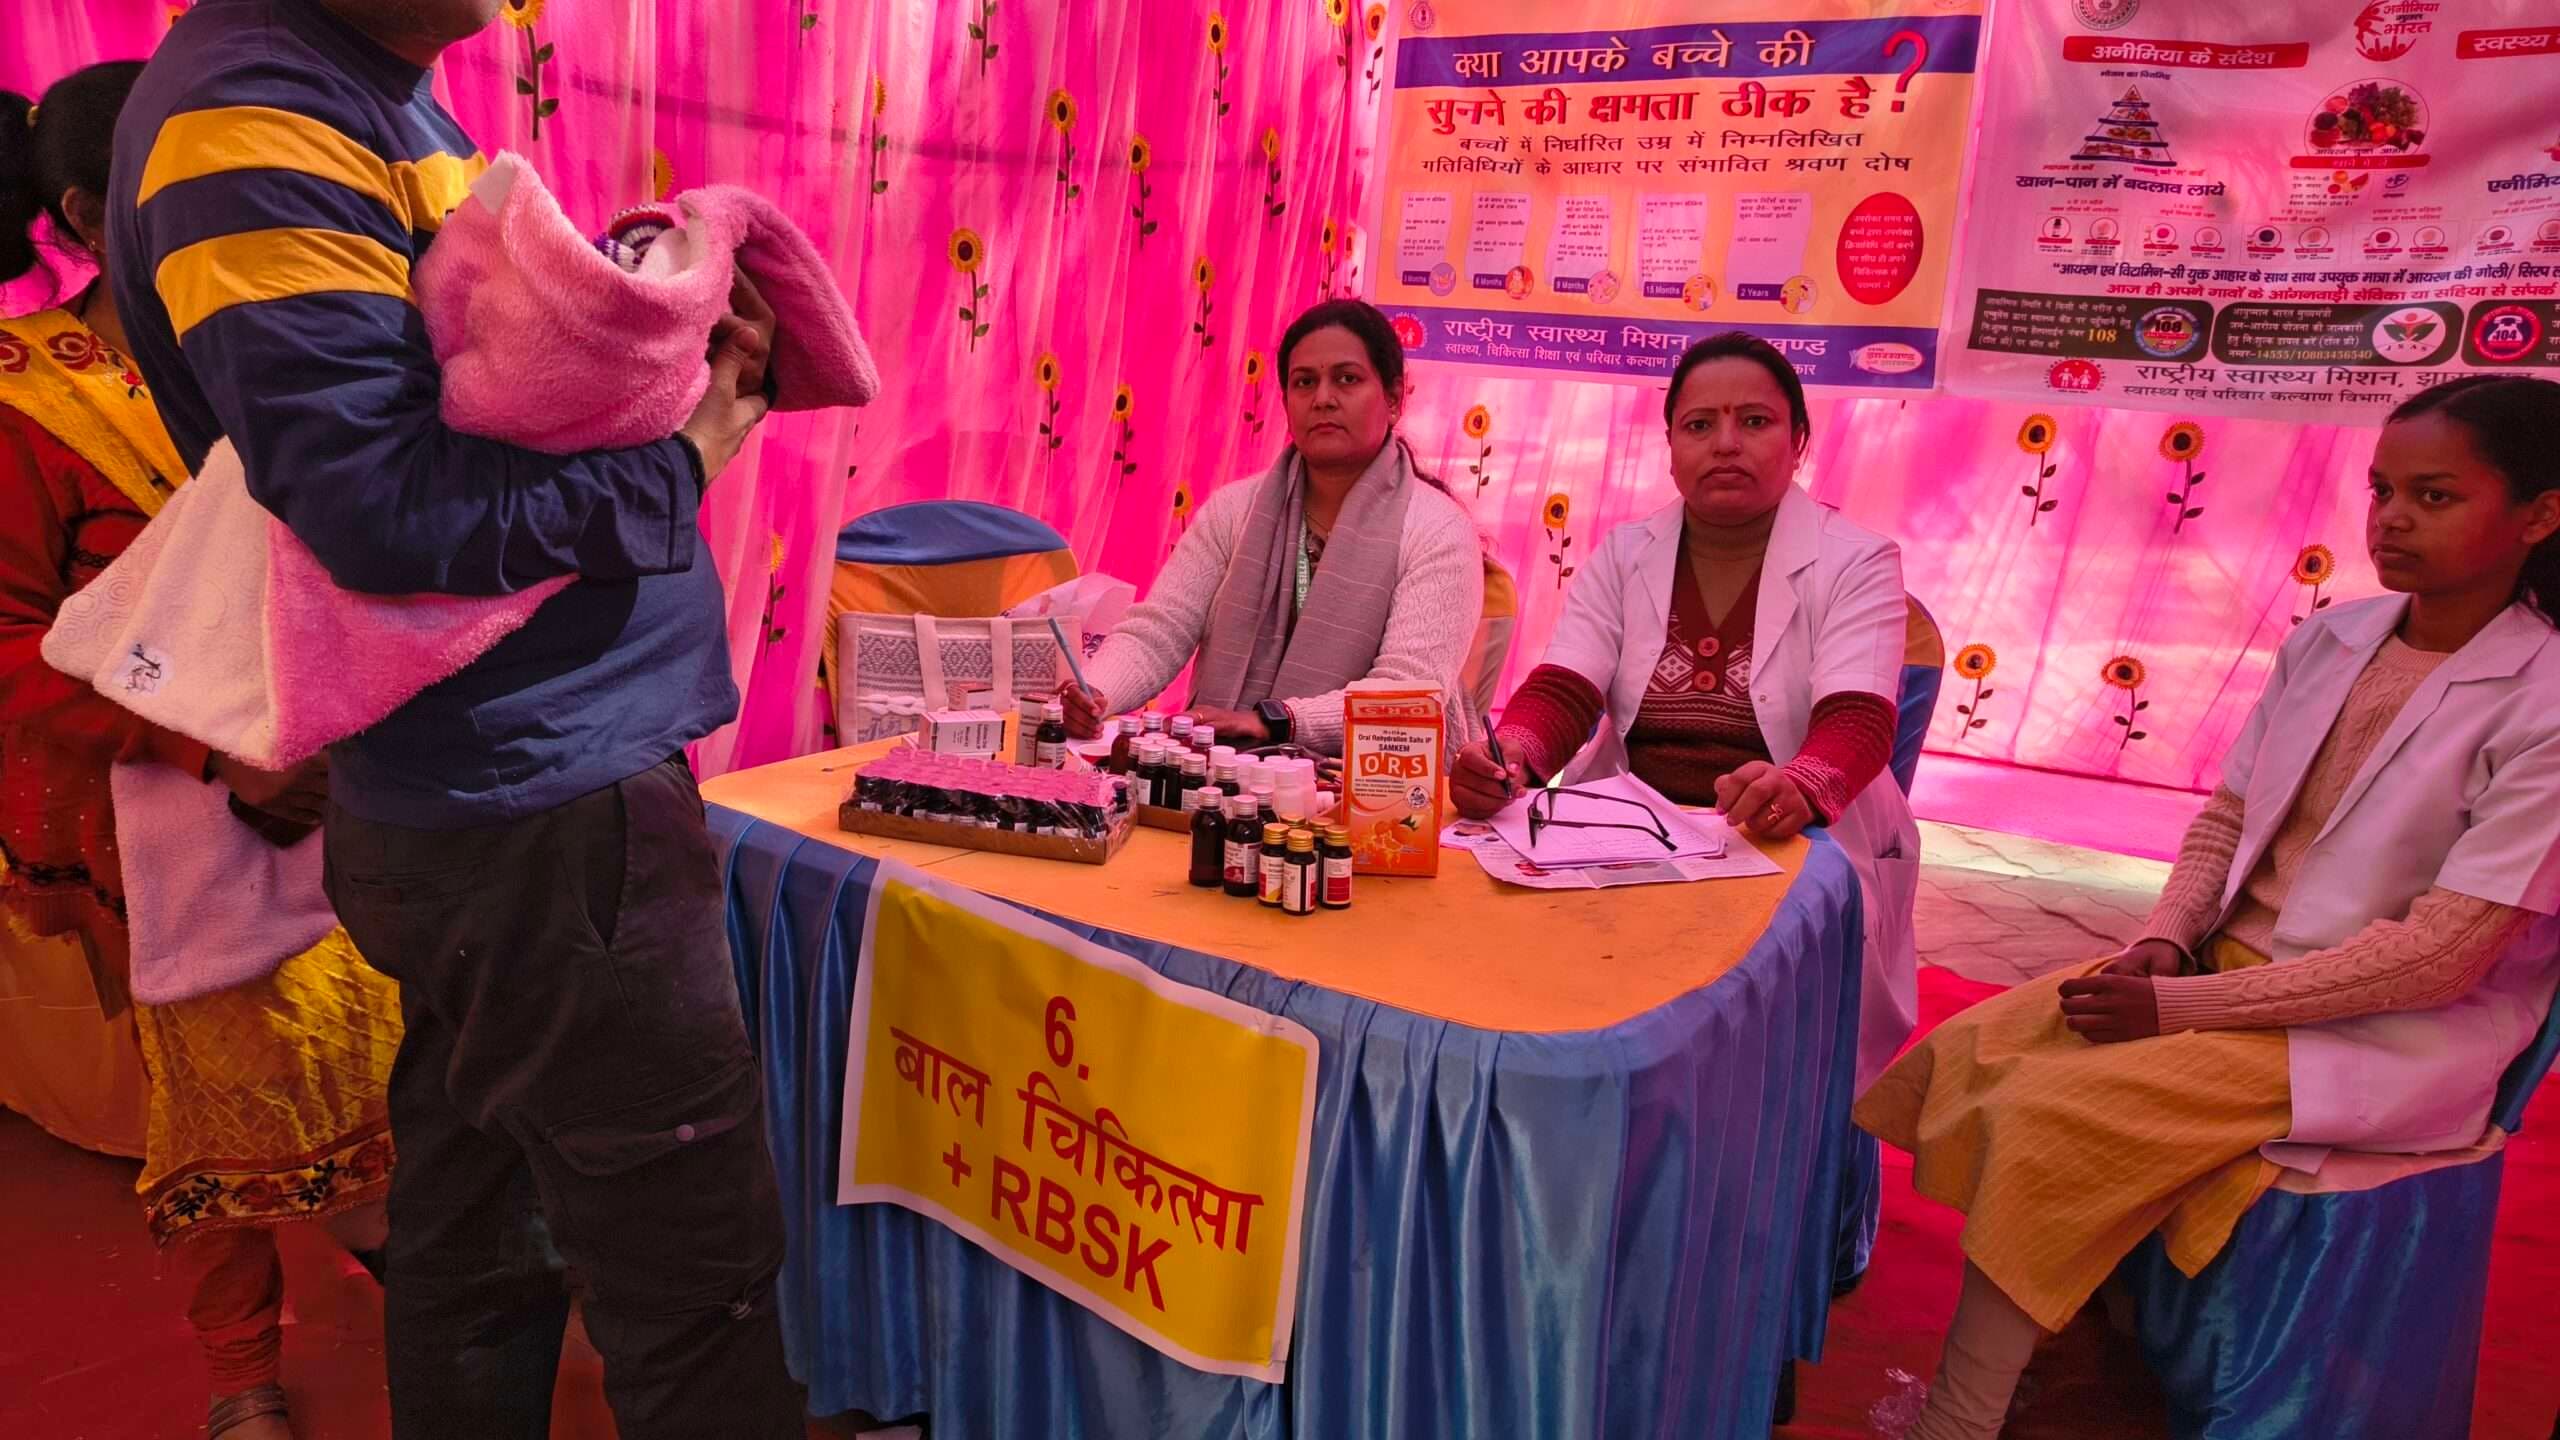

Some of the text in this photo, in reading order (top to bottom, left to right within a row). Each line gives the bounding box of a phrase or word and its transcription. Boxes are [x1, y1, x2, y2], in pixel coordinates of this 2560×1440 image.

[2384, 21, 2432, 34] भारत
[1453, 29, 1816, 78] क्या आपके बच्चे की
[2091, 42, 2277, 65] अनीमिया के संदेश
[1424, 89, 1506, 135] सुनने
[1521, 88, 1571, 125] की
[1588, 92, 1700, 123] क्षमता
[1720, 81, 1815, 118] ठीक
[1460, 129, 1864, 152] बच्चों में निर्धारित उम्र में निम्नलिखित
[1421, 152, 1913, 175] गतिविधियों के आधार पर संभावित श्रवण दोष
[2102, 174, 2123, 189] में
[2124, 178, 2182, 195] बदलाव
[2187, 181, 2226, 196] लाये
[2100, 263, 2119, 277] एवं
[2212, 269, 2246, 281] आहार
[2249, 269, 2262, 282] के
[2264, 271, 2288, 283] साथ
[2291, 271, 2315, 283] साथ
[2362, 271, 2390, 283] मात्रा
[2392, 268, 2407, 283] में
[2454, 266, 2472, 280] की
[1740, 288, 1769, 297] 2 Years
[2106, 284, 2141, 294] आज
[2145, 282, 2161, 296] ही
[2167, 284, 2204, 297] अपने
[2247, 286, 2263, 298] के
[2353, 287, 2405, 301] सेविका
[2410, 290, 2429, 300] या
[2435, 285, 2485, 298] सहिया
[2491, 285, 2507, 297] से
[2511, 281, 2559, 296] संपर्क
[1443, 318, 1514, 341] राष्ट्रीय
[1527, 323, 1607, 345] स्वास्थ्य
[2088, 328, 2117, 343] 108
[2155, 320, 2183, 333] 108
[2495, 329, 2517, 340] 104
[1487, 341, 1529, 359] चिकित्सा
[1534, 344, 1560, 361] शिक्षा
[1566, 350, 1582, 364] एवं
[1586, 347, 1621, 365] परिवार
[1626, 355, 1666, 369] कल्याण
[2136, 364, 2404, 388] राष्ट्रीय स्वास्थ्य मिशन,
[2123, 385, 2179, 397] स्वास्थ्य
[2184, 385, 2209, 400] एवं
[2212, 387, 2265, 400] परिवार
[2271, 391, 2332, 403] कल्याण
[1358, 733, 1370, 741] Oral
[1372, 734, 1407, 742] Rehydration
[1044, 996, 1090, 1080] 6.
[890, 1027, 1264, 1254] बाल चिकित्सा
[991, 1154, 1173, 1312] RBSK
